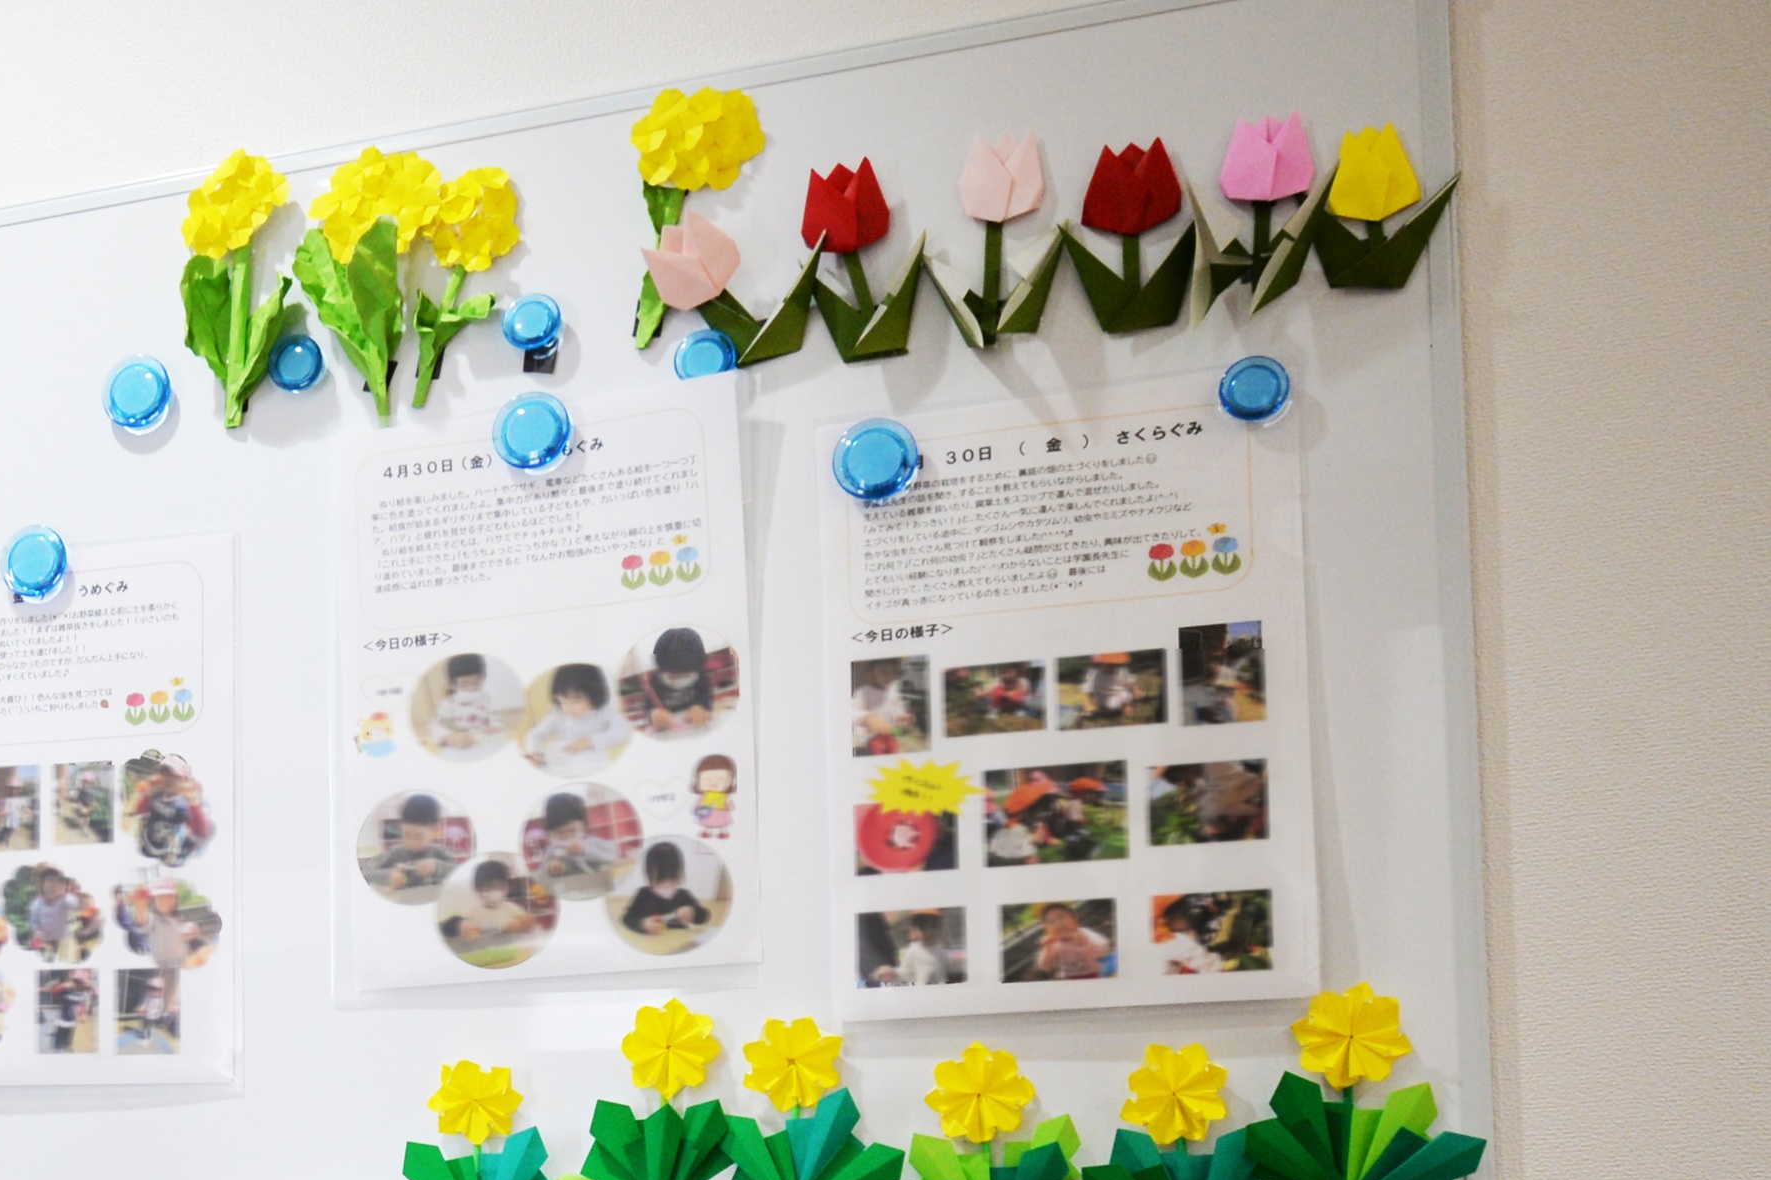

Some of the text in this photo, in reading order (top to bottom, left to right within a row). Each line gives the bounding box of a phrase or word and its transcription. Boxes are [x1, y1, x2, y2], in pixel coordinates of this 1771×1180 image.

[1117, 421, 1203, 445] さくらぐみ
[79, 580, 129, 597] うめぐみ
